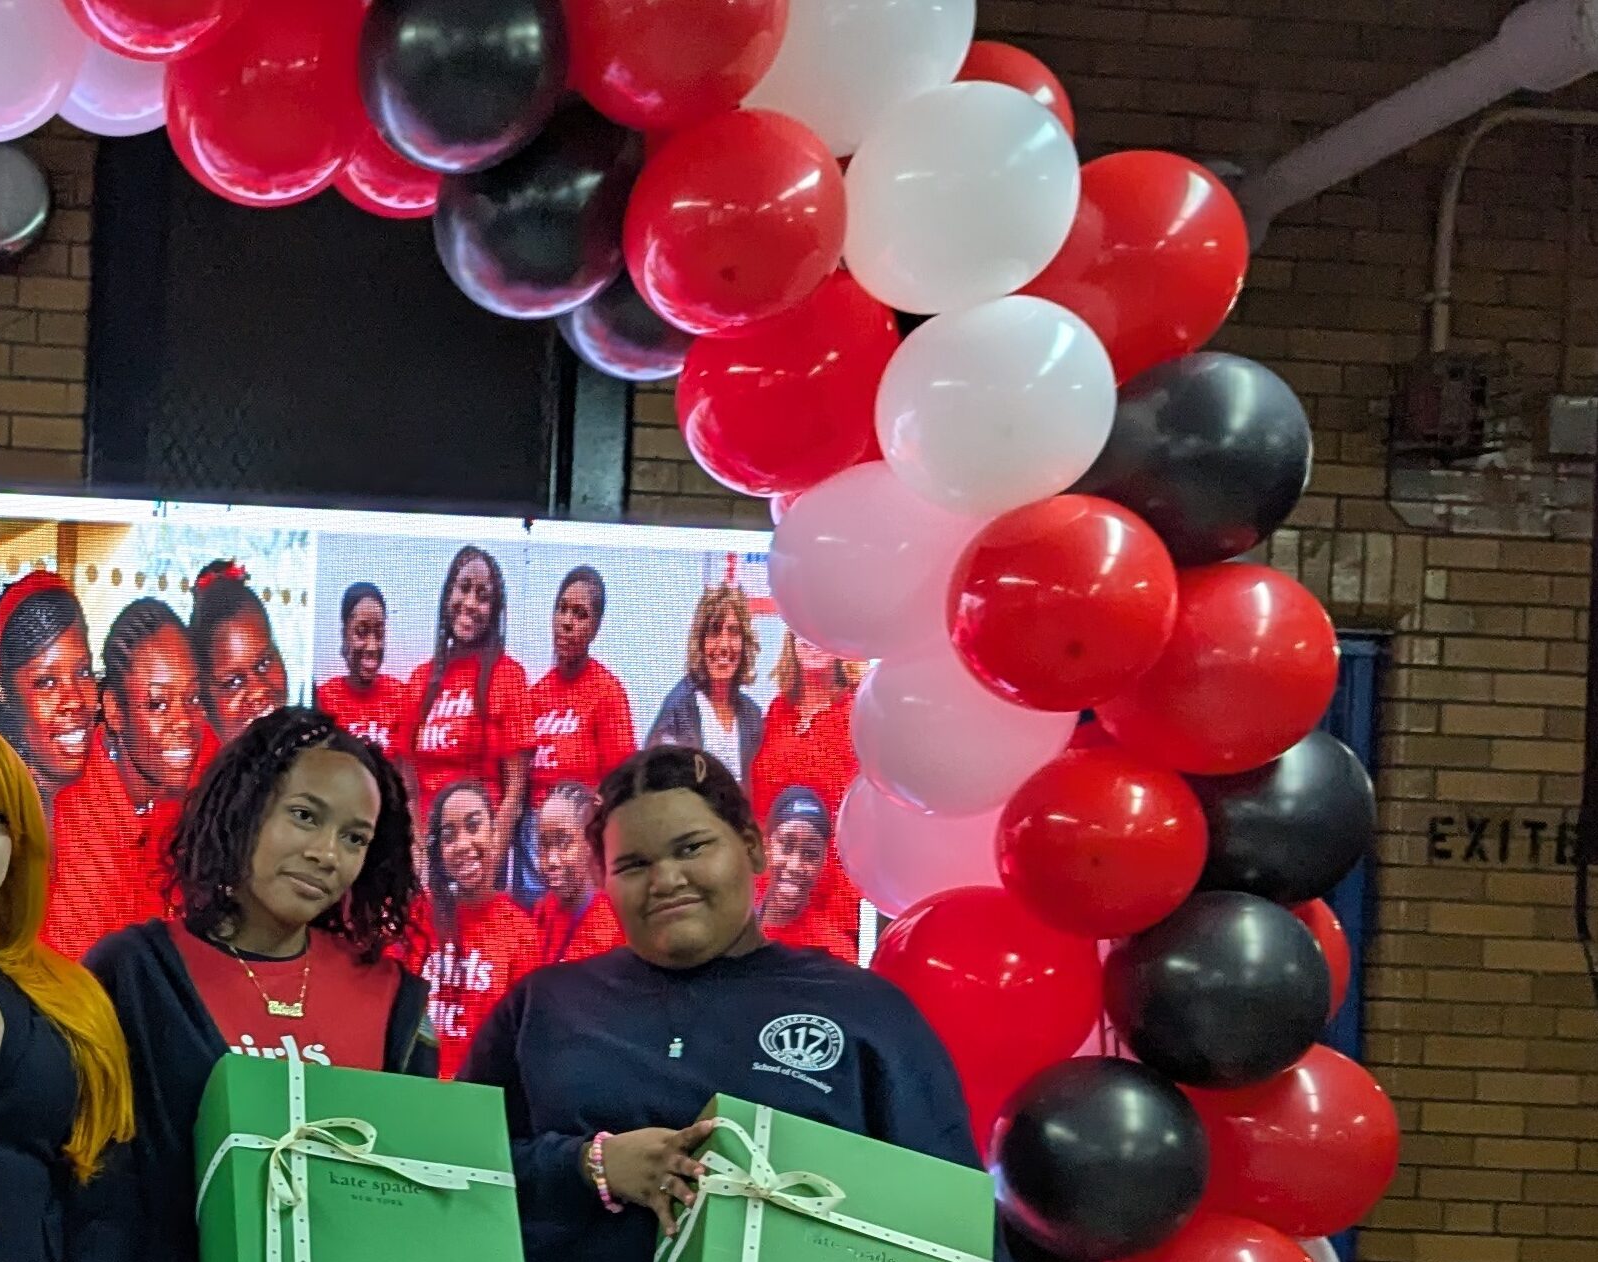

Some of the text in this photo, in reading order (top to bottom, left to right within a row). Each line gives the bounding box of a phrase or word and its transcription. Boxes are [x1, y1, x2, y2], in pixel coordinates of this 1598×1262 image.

[778, 1026, 828, 1055] 117
[751, 1061, 781, 1074] School
[328, 1171, 423, 1197] kate spade
